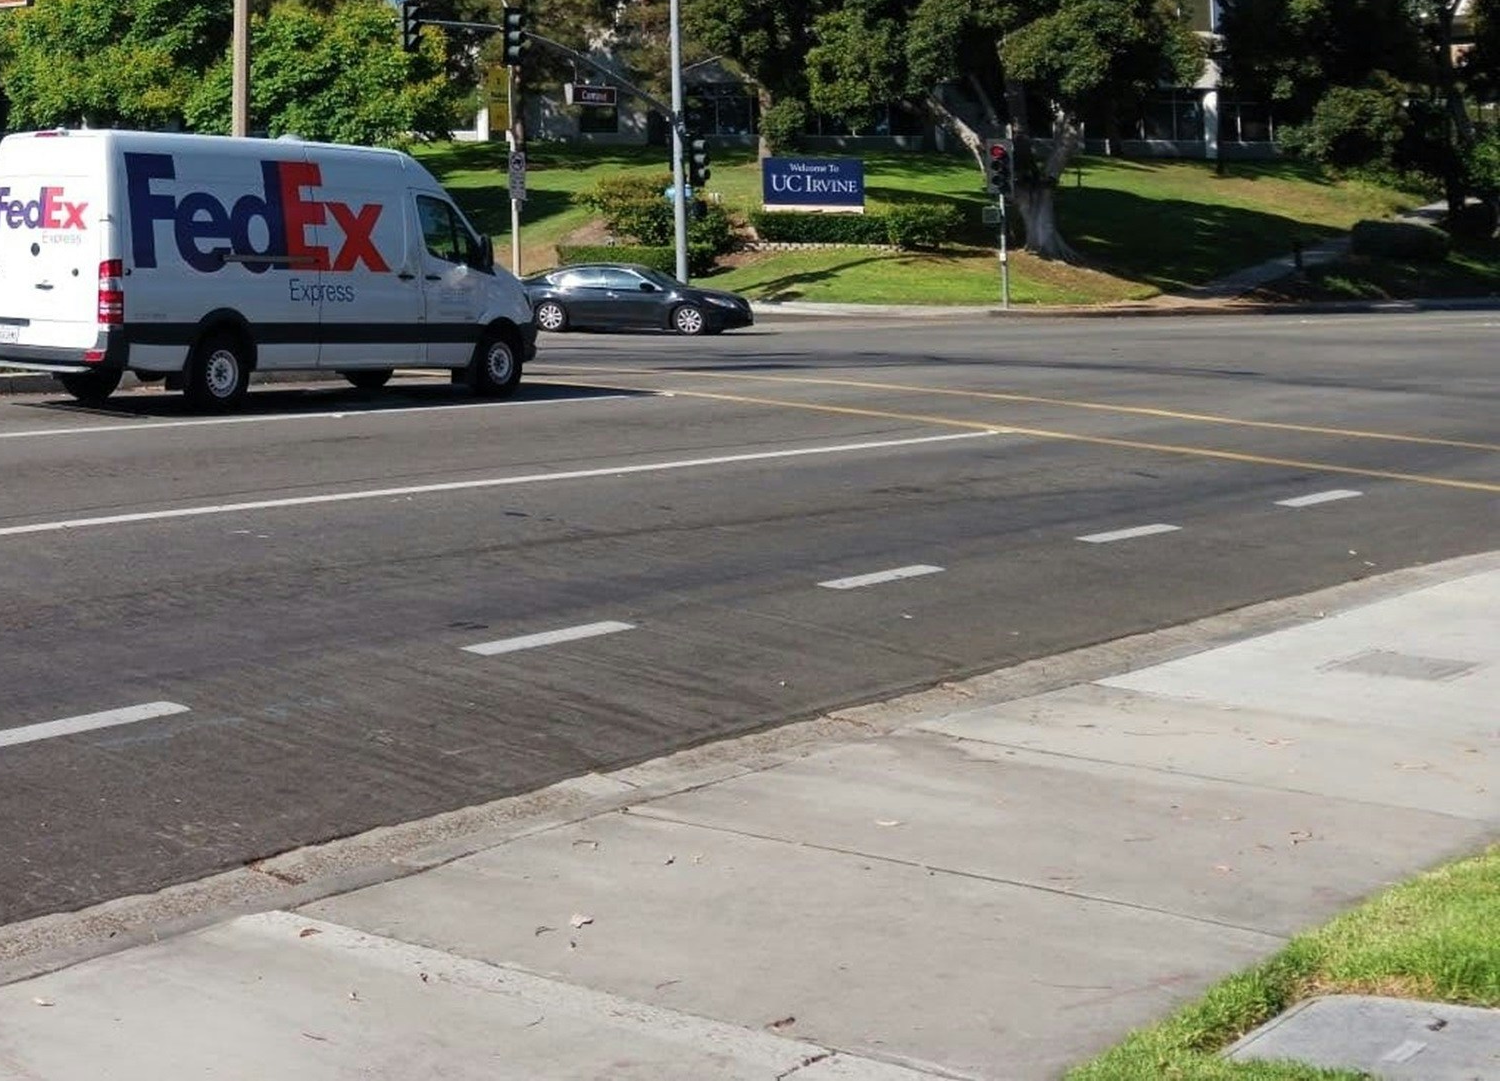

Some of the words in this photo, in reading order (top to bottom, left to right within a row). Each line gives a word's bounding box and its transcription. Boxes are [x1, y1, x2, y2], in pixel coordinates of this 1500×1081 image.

[789, 163, 827, 173] Welcome
[827, 164, 840, 173] To
[771, 174, 802, 192] UC
[124, 152, 391, 274] FedEx
[42, 232, 82, 246] Express
[289, 278, 356, 306] Express
